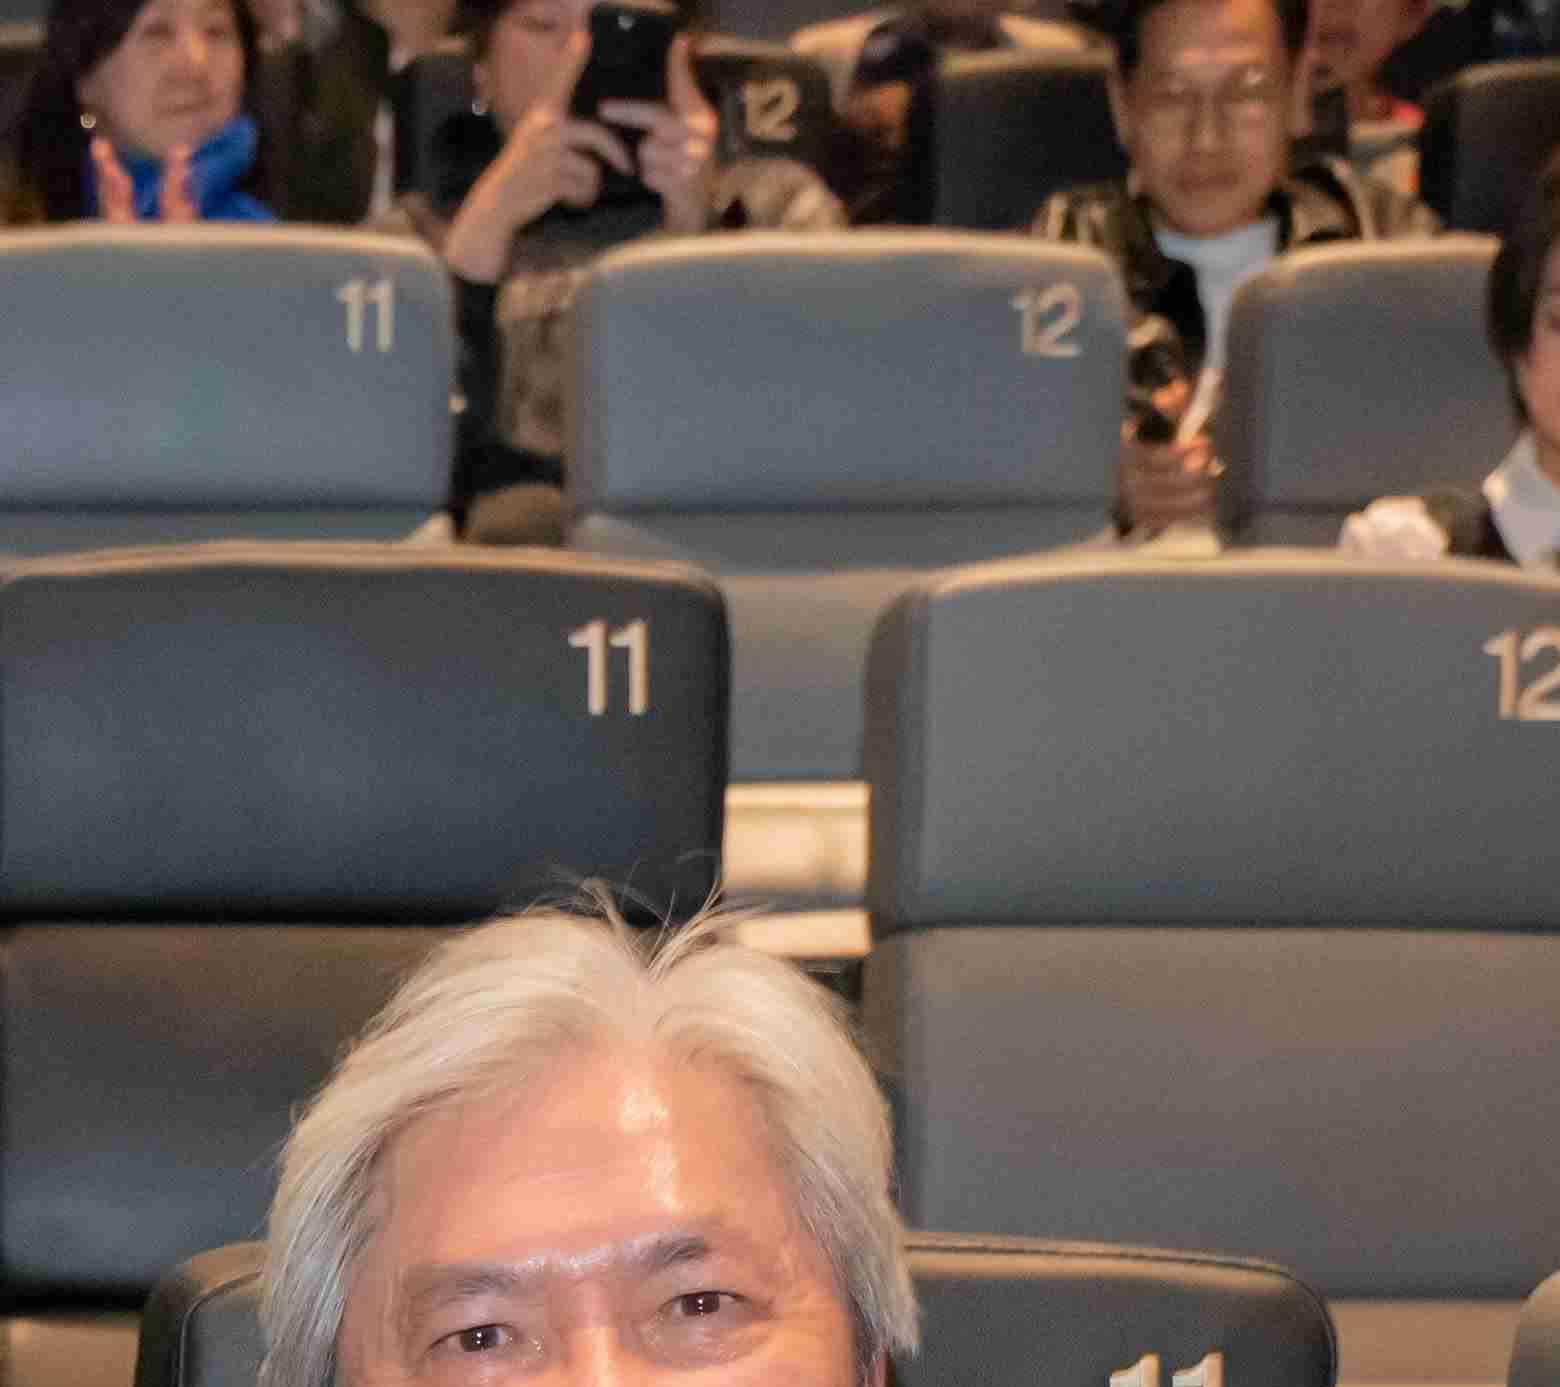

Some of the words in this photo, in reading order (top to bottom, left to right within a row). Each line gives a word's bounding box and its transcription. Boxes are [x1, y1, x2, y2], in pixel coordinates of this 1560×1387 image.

[741, 77, 798, 141] 12
[335, 278, 394, 352] 11
[1011, 283, 1082, 358] 12
[568, 620, 648, 715] 11
